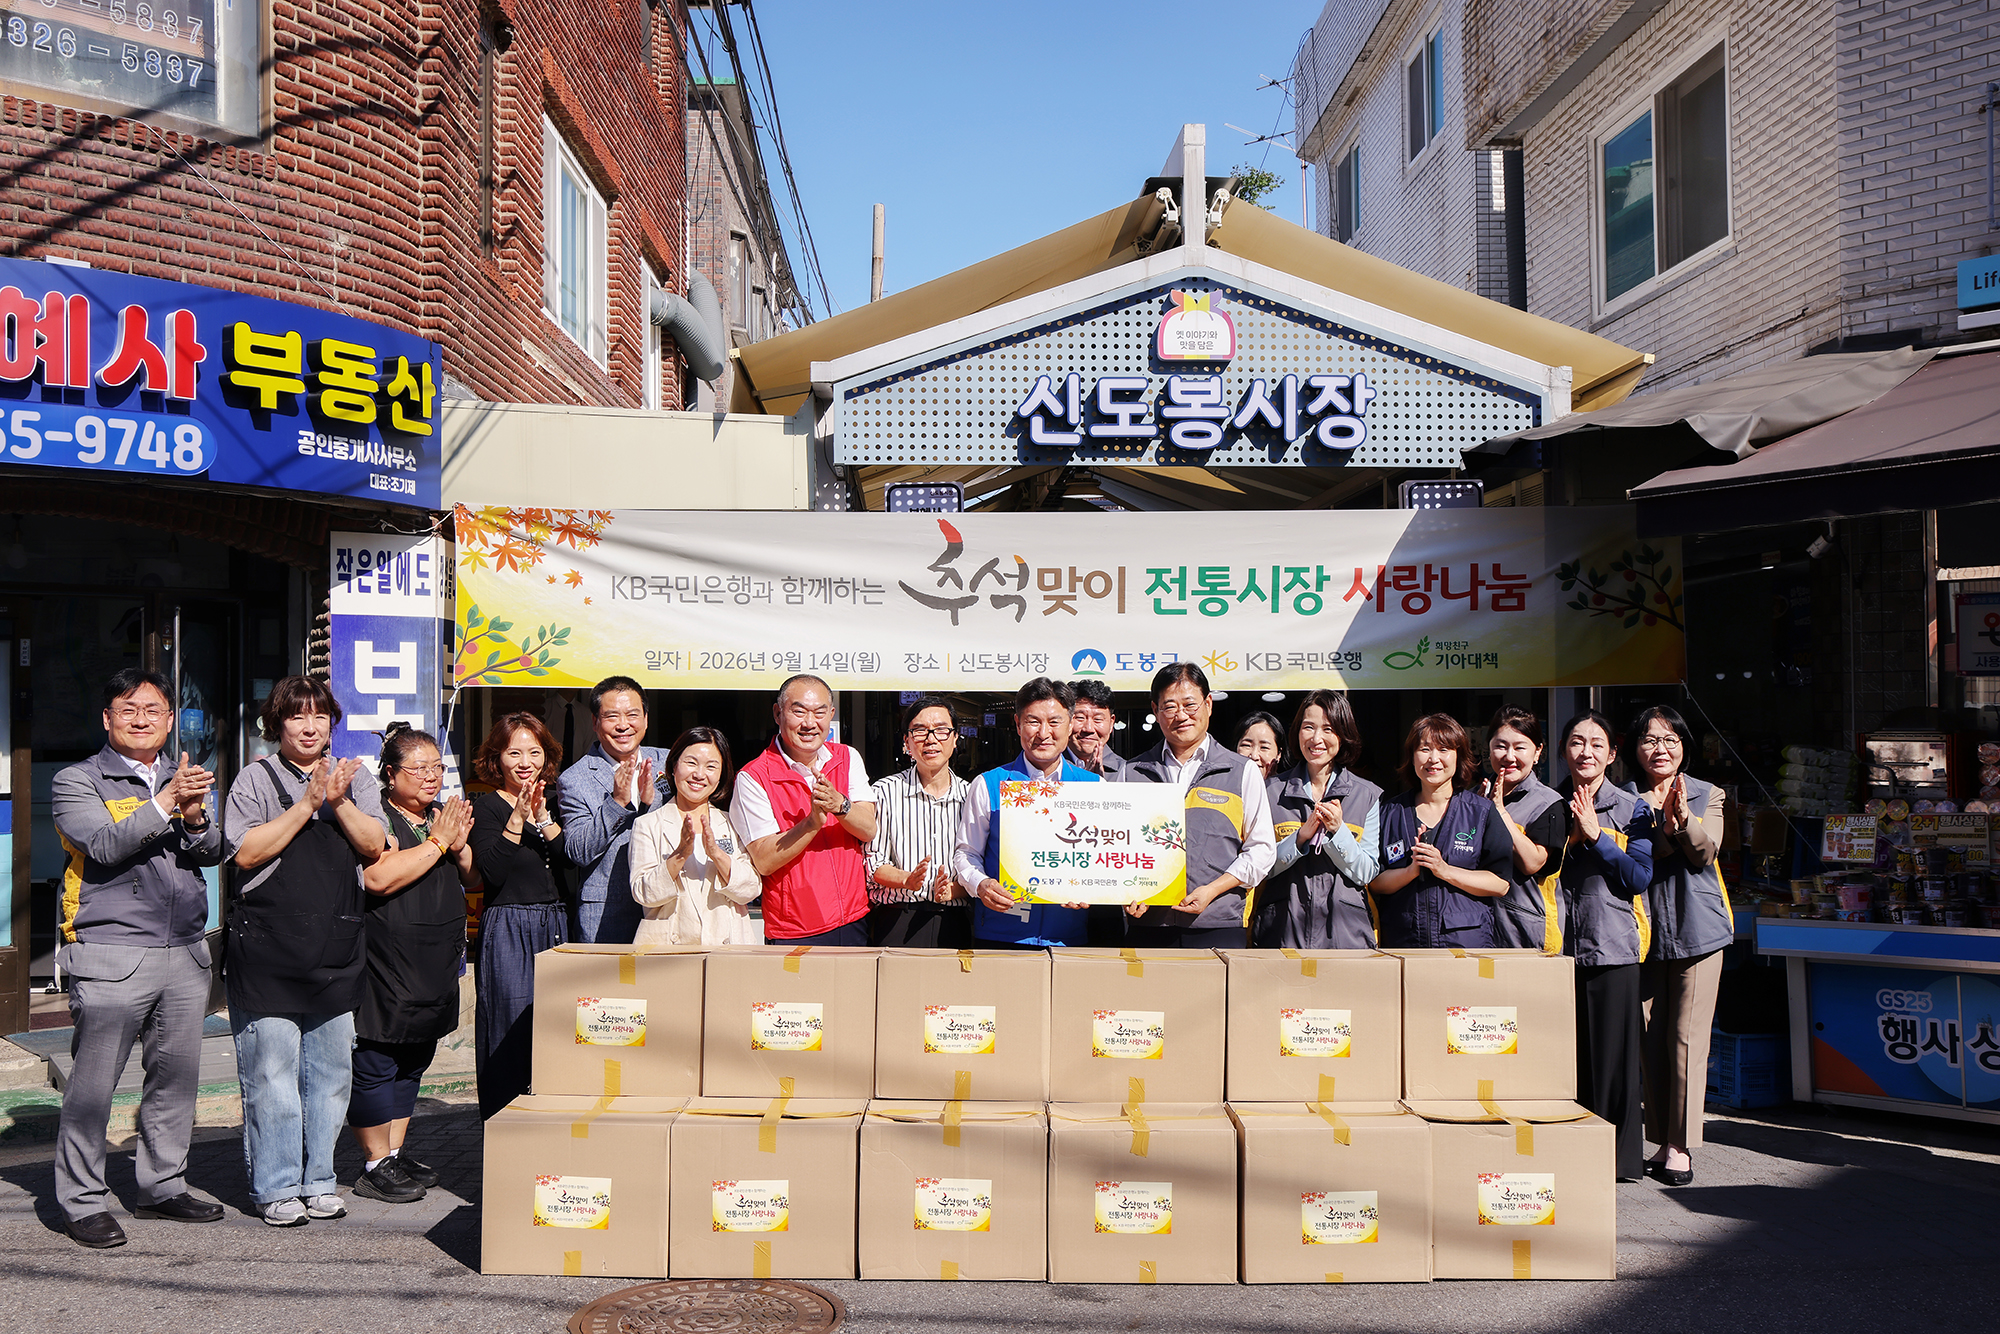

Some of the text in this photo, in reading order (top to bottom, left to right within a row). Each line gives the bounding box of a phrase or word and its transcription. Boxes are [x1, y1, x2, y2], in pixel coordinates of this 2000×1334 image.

[40, 0, 203, 45] -5837
[0, 16, 203, 88] 326-5837
[1974, 270, 2000, 290] Lif
[1185, 330, 1218, 340] 이야기와
[1197, 340, 1214, 350] 담은
[229, 321, 437, 436] 부동산
[1017, 372, 1377, 450] 신도봉시장
[0, 407, 204, 471] 5-9748
[297, 429, 417, 472] 공인중개사사무소
[336, 547, 432, 597] 작은일에도
[610, 517, 1532, 627] KB국민은행과 함께하는 추석맞이 전통시장 사랑나눔
[1435, 640, 1469, 650] 희망친구
[644, 650, 1050, 674] 일자 2026년 9월 14일(월) 장소 신도봉시장
[1435, 652, 1499, 670] 기아대책
[1976, 655, 2000, 668] 사용
[1053, 800, 1132, 810] KB국민은행과 함께하는
[1054, 812, 1130, 849] 추석맞이
[1826, 816, 1876, 831] 2+1 행사상품
[1911, 815, 1986, 831] 2+1 행사상품
[1031, 851, 1155, 869] 전통시장 사랑나눔
[1041, 878, 1062, 886] 도봉구
[1879, 990, 1931, 1011] GS25
